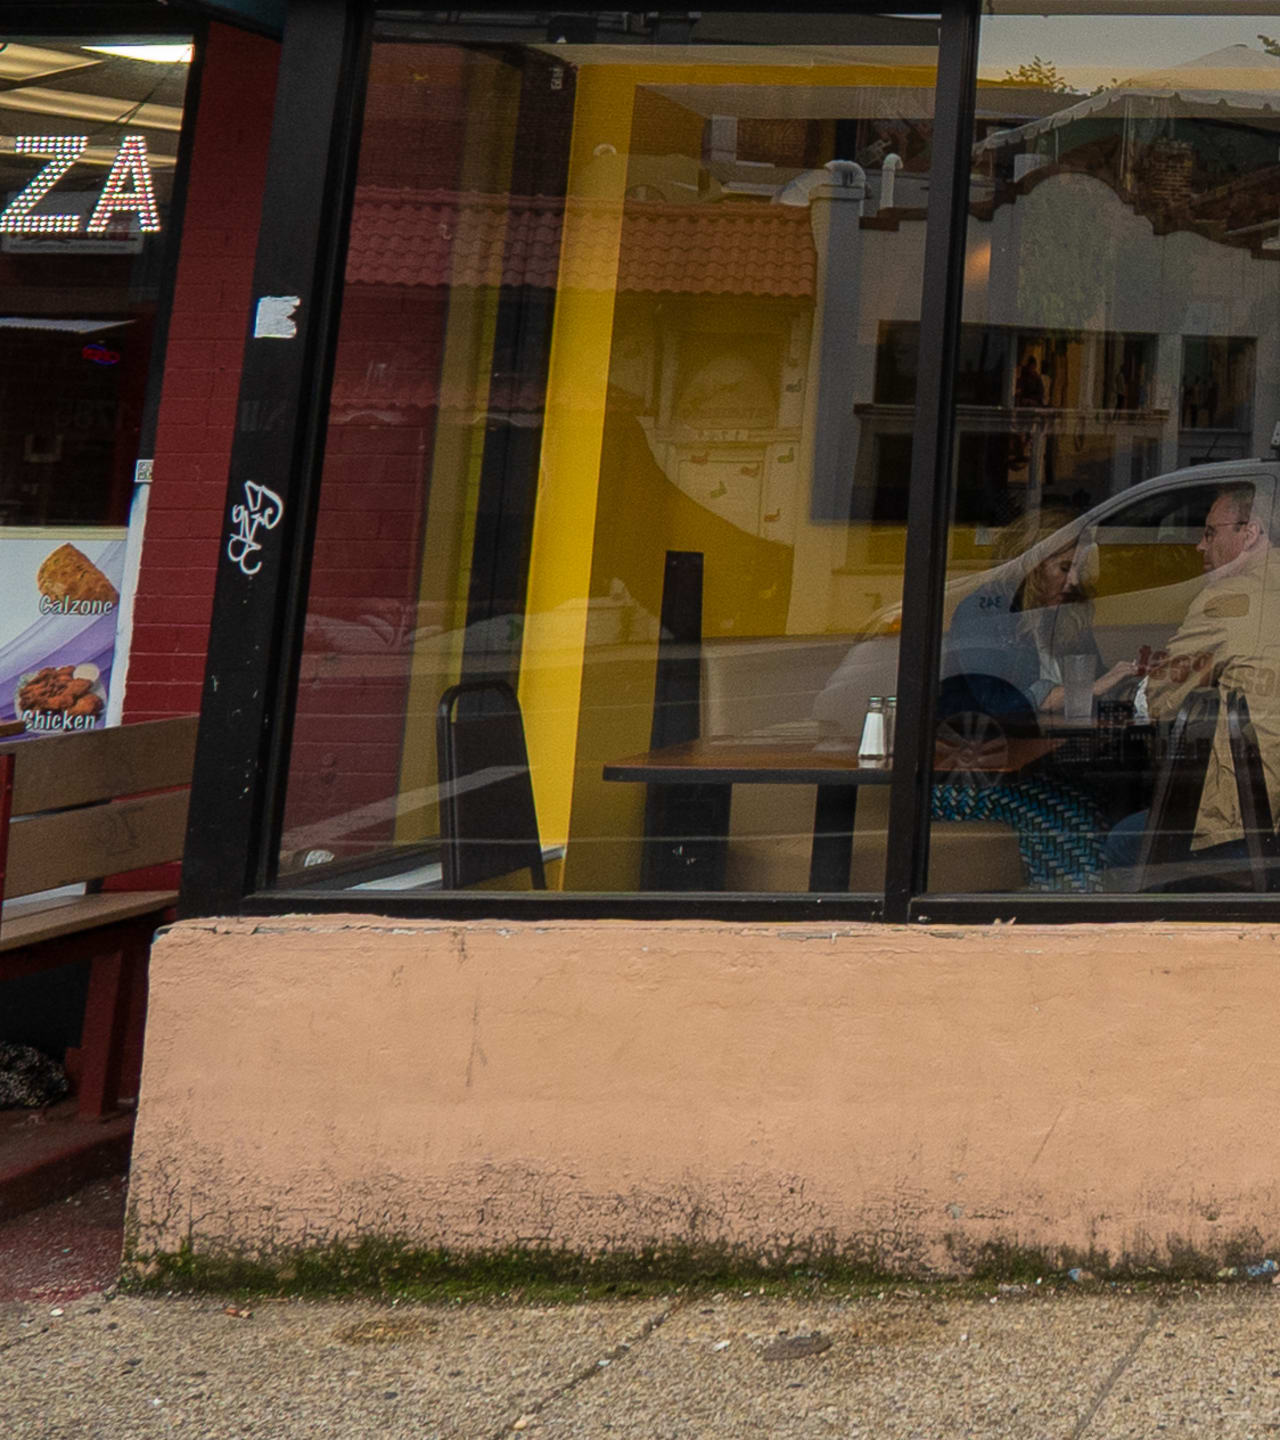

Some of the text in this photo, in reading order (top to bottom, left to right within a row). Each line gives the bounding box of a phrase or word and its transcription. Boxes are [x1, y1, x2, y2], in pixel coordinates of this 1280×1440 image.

[0, 136, 161, 232] ZA
[39, 594, 113, 616] Calzone
[22, 709, 96, 733] Chicken
